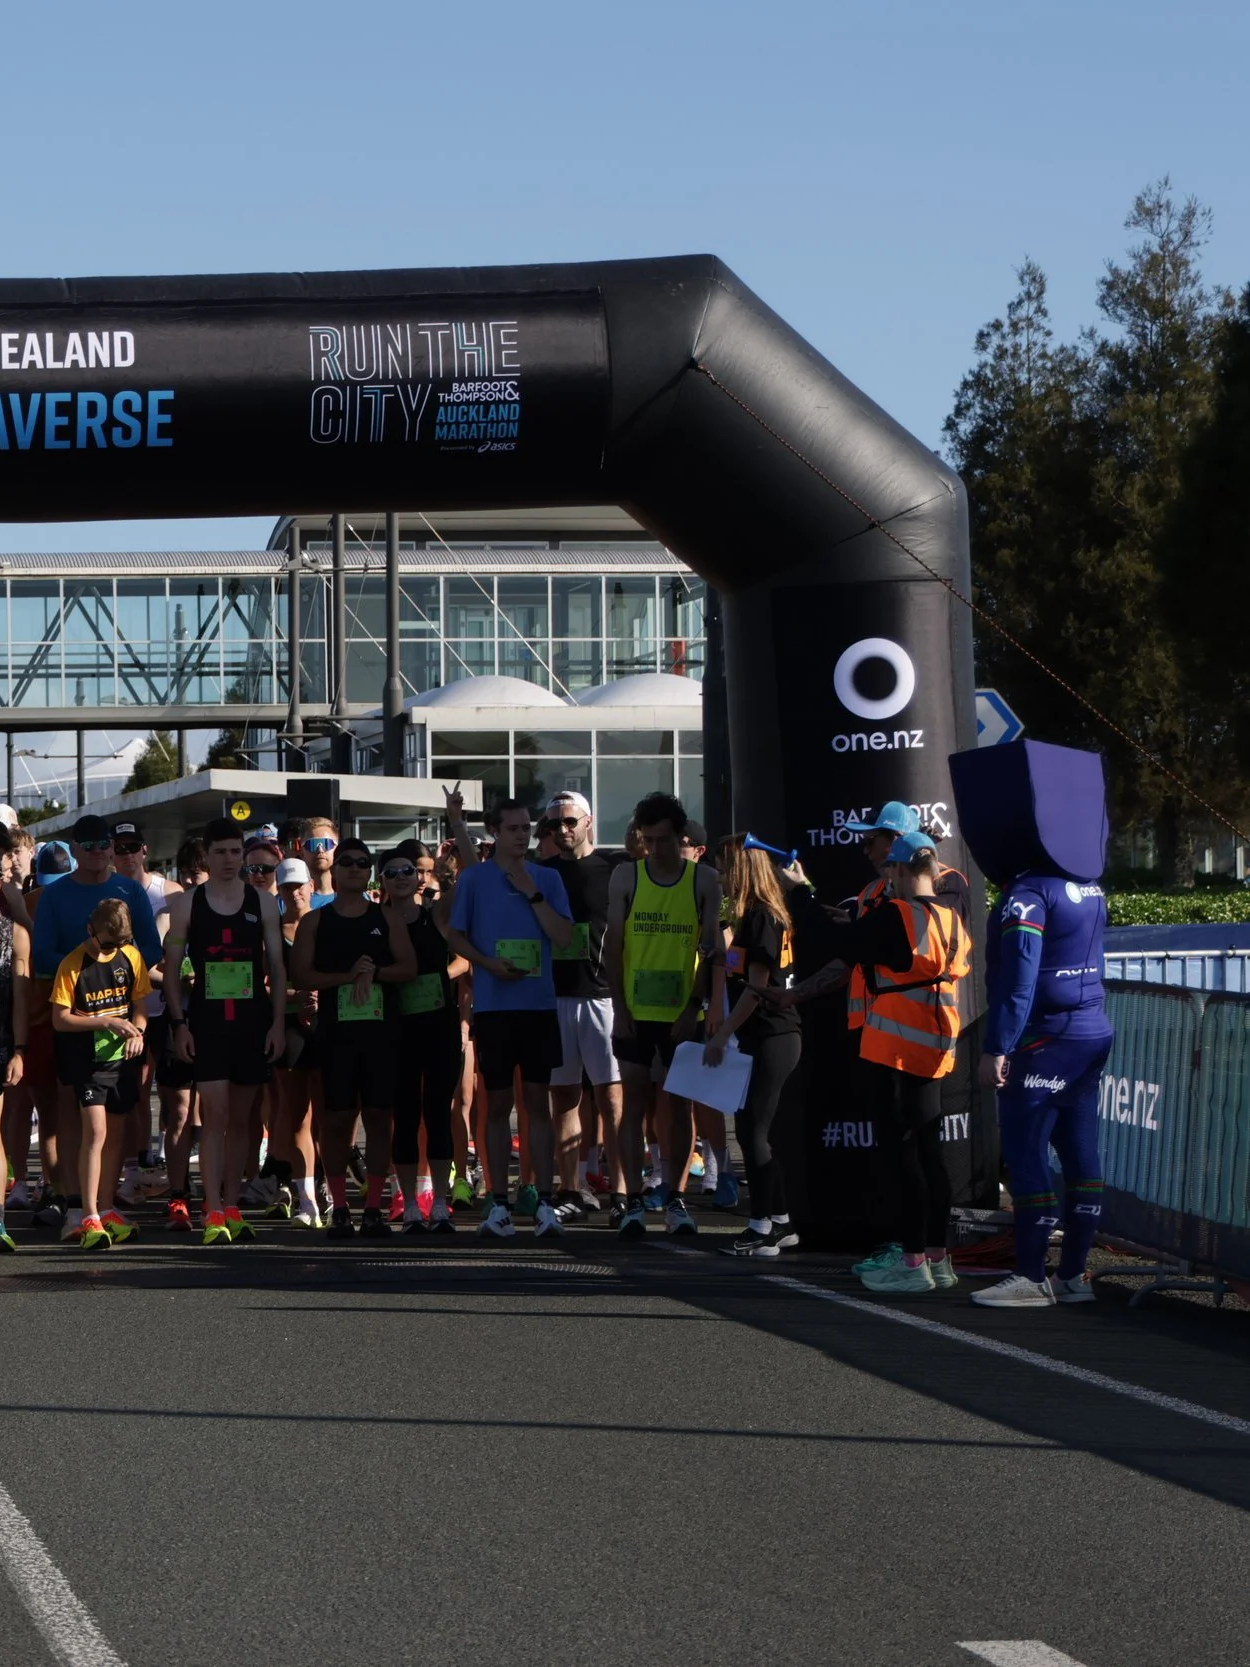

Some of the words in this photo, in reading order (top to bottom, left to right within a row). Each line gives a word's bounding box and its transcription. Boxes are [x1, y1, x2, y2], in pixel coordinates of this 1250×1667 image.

[309, 323, 412, 381] RUN
[418, 321, 521, 378] THE
[452, 381, 506, 393] BARFOOT
[438, 391, 505, 403] THOMPSON
[310, 384, 431, 444] CITY
[436, 403, 520, 423] AUCKLAND
[435, 422, 518, 440] MARATHON
[832, 729, 924, 752] one.nz
[237, 805, 246, 816] A
[634, 911, 669, 922] MONDAY
[634, 922, 693, 935] UNDERGROUND
